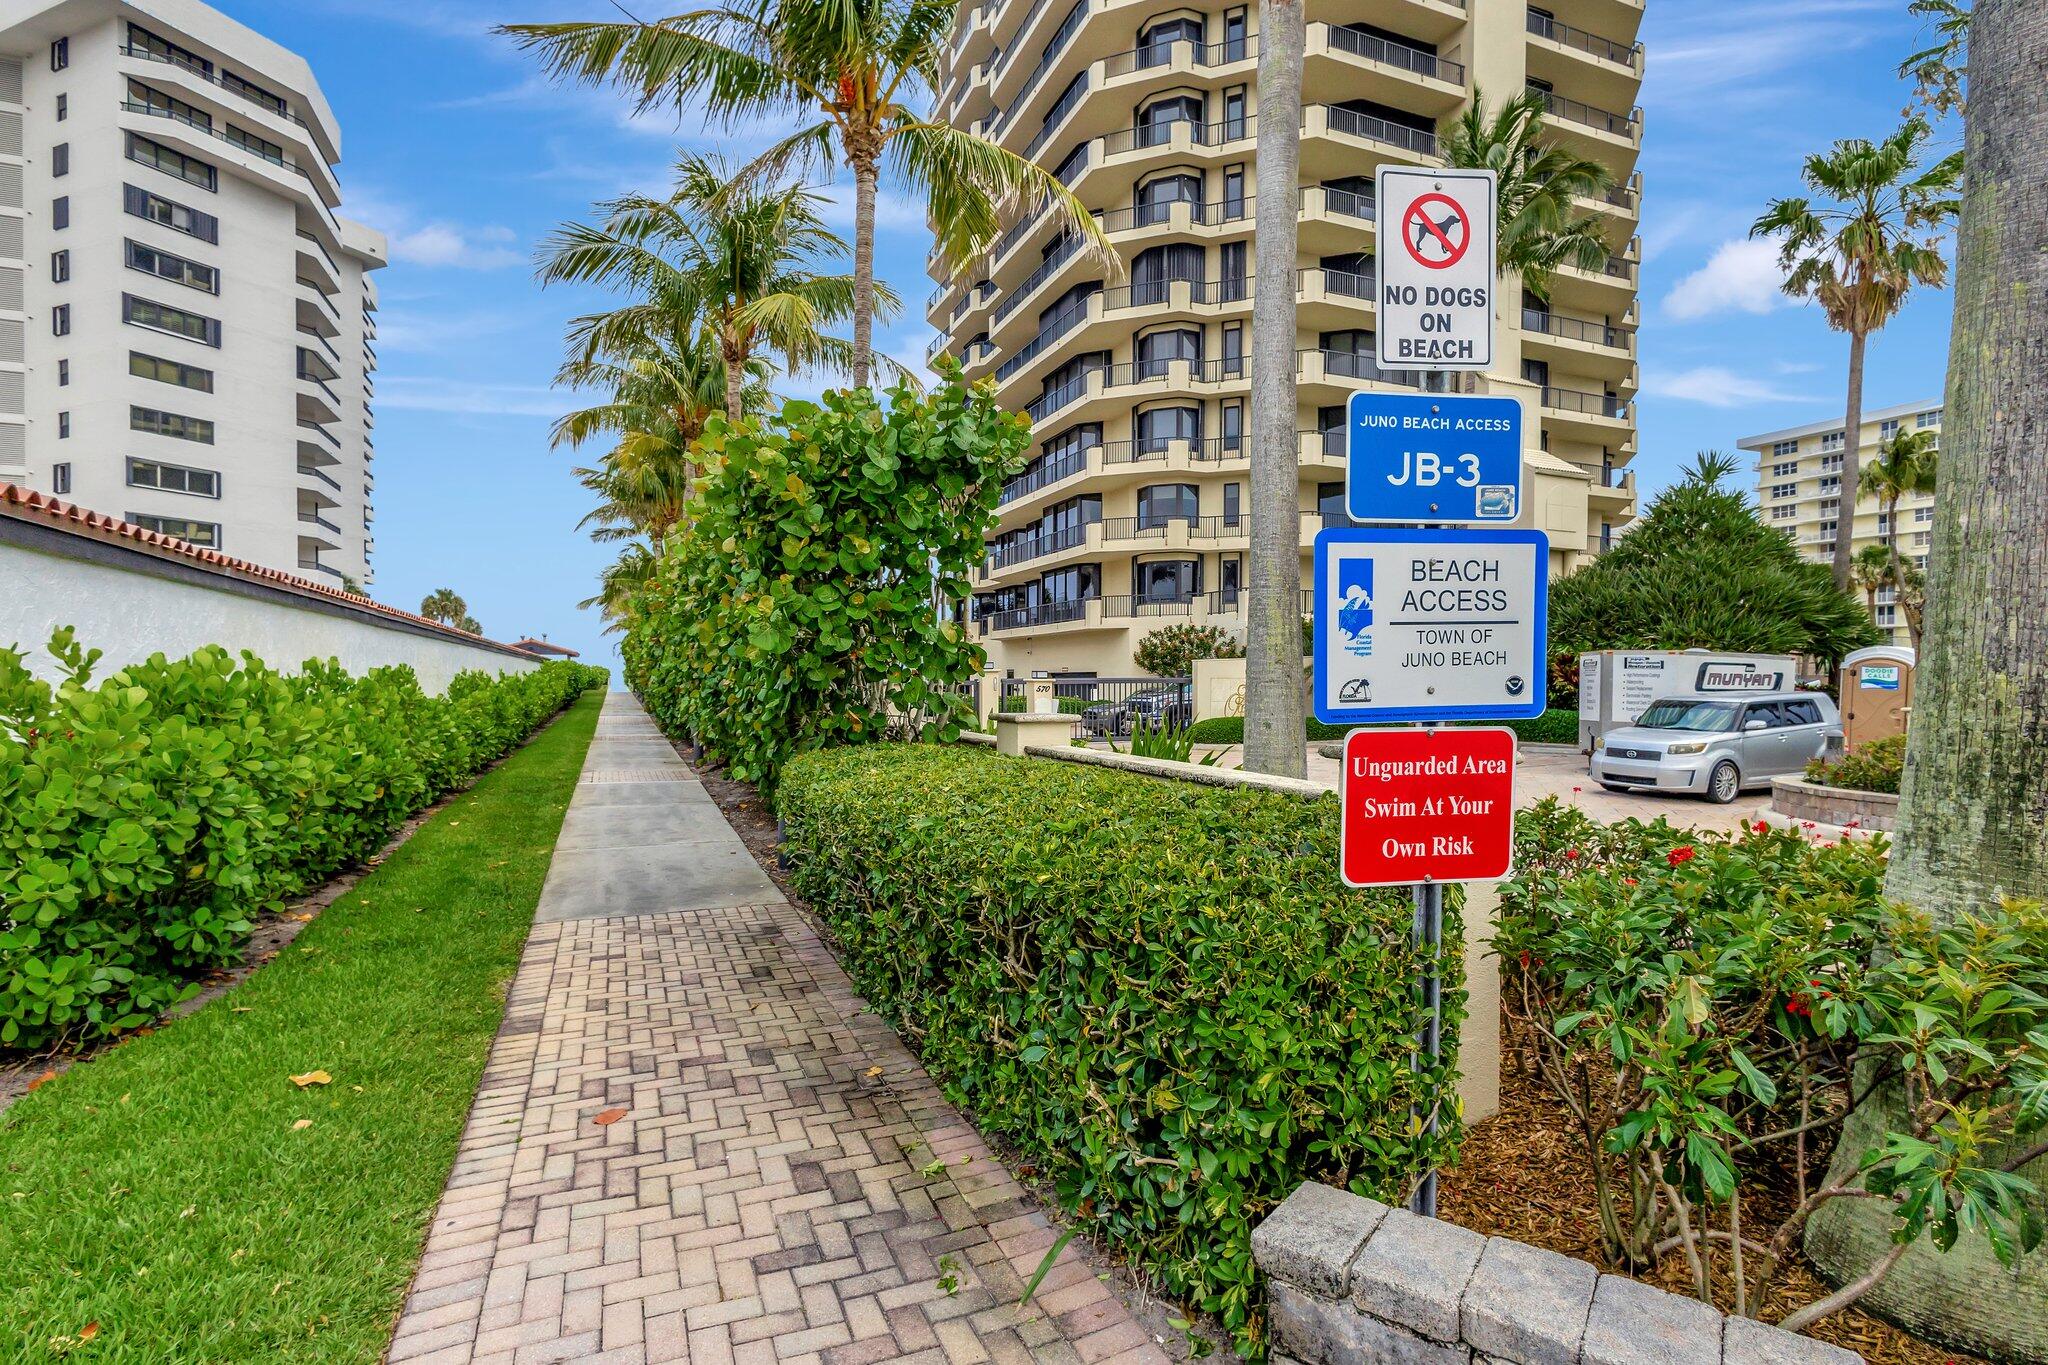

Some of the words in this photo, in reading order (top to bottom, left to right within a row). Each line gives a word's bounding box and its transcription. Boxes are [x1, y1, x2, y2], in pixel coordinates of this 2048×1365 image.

[1386, 285, 1417, 305] NO
[1426, 287, 1486, 308] DOGS
[1420, 313, 1451, 332] ON
[1398, 338, 1472, 358] BEACH
[1360, 415, 1397, 428] JUNO
[1403, 417, 1449, 429] BEACH
[1455, 419, 1511, 431] ACCESS
[1387, 452, 1481, 487] JB-3
[1411, 559, 1499, 582] BEACH
[1401, 590, 1507, 612] ACCESS
[1416, 629, 1465, 645] TOWN
[1471, 629, 1493, 644] OF
[1401, 652, 1445, 667] JUNO
[1451, 651, 1507, 666] BEACH
[1036, 685, 1051, 693] 570
[1353, 755, 1457, 782] Unguarded
[1462, 755, 1507, 775] Area
[1364, 797, 1416, 818] Swim
[1420, 796, 1444, 816] At
[1448, 795, 1494, 816] Your
[1382, 838, 1426, 859] Own
[1431, 836, 1474, 857] Risk
